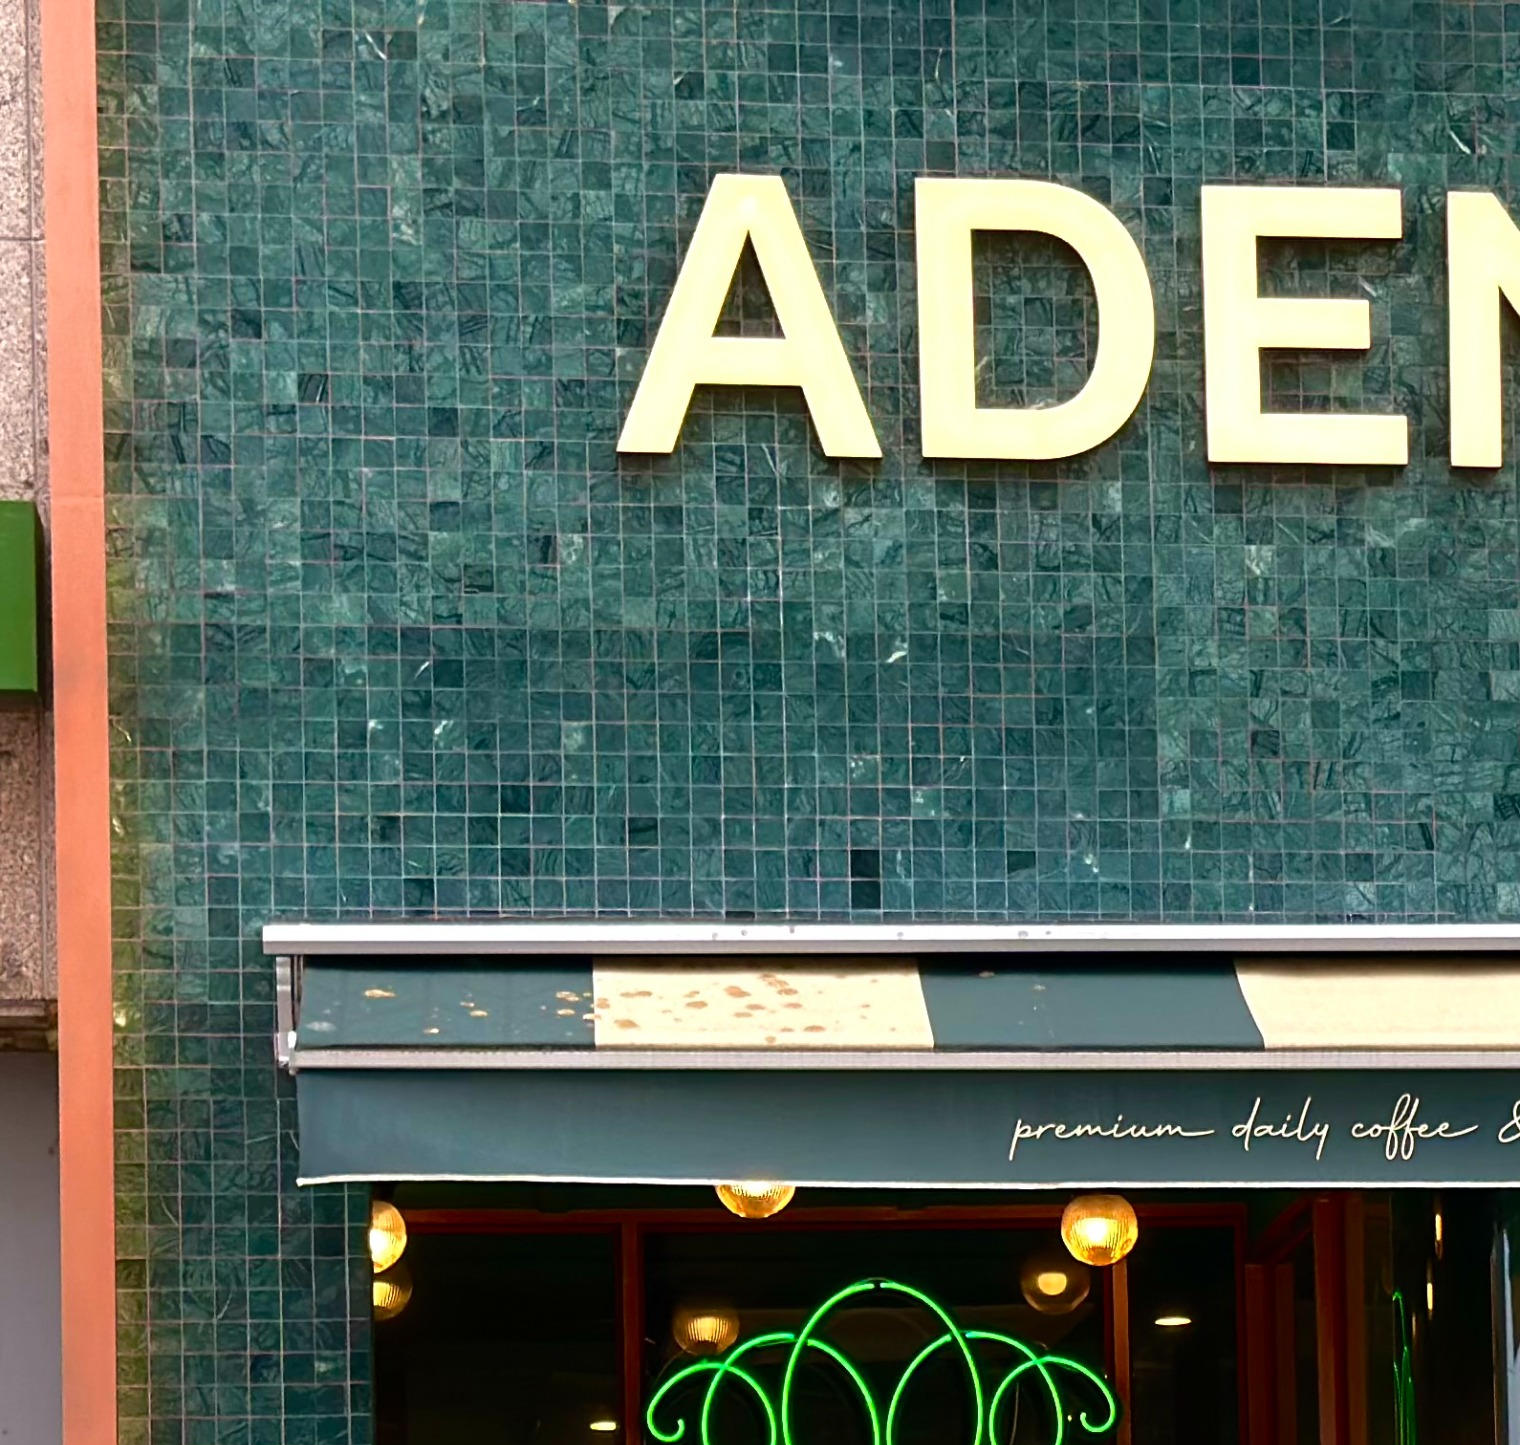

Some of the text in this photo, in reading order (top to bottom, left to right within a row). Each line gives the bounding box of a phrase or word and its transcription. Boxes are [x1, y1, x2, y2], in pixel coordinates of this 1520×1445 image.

[1009, 1115, 1214, 1158] premium
[1232, 1097, 1328, 1158] daily
[1351, 1094, 1478, 1158] coffee
